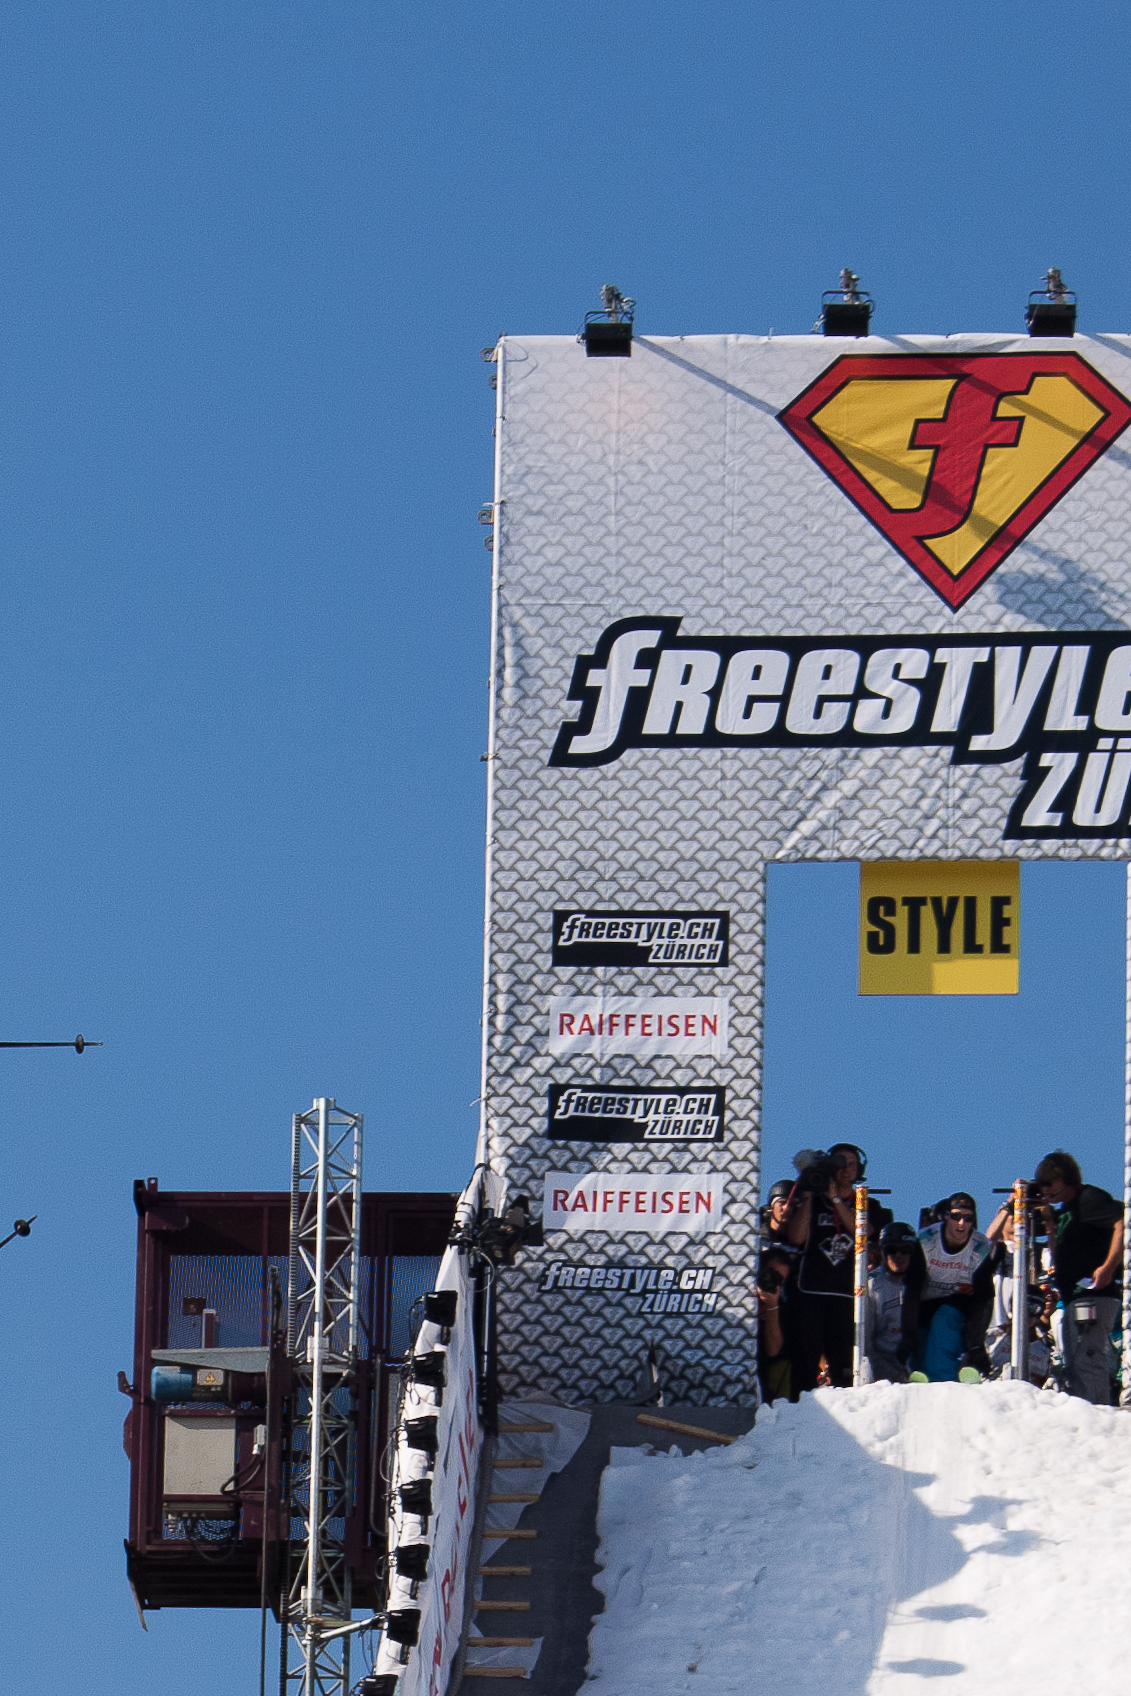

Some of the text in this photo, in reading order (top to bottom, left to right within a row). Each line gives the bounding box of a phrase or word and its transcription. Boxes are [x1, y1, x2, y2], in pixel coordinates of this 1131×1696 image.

[865, 895, 1012, 956] STYLE
[651, 940, 720, 961] ZÜRICH
[558, 1012, 718, 1037] RAIFFEISEN
[648, 1116, 716, 1136] ZÜRICH
[552, 1188, 712, 1214] RAIFFEISEN
[640, 1290, 718, 1313] ZÜRICH
